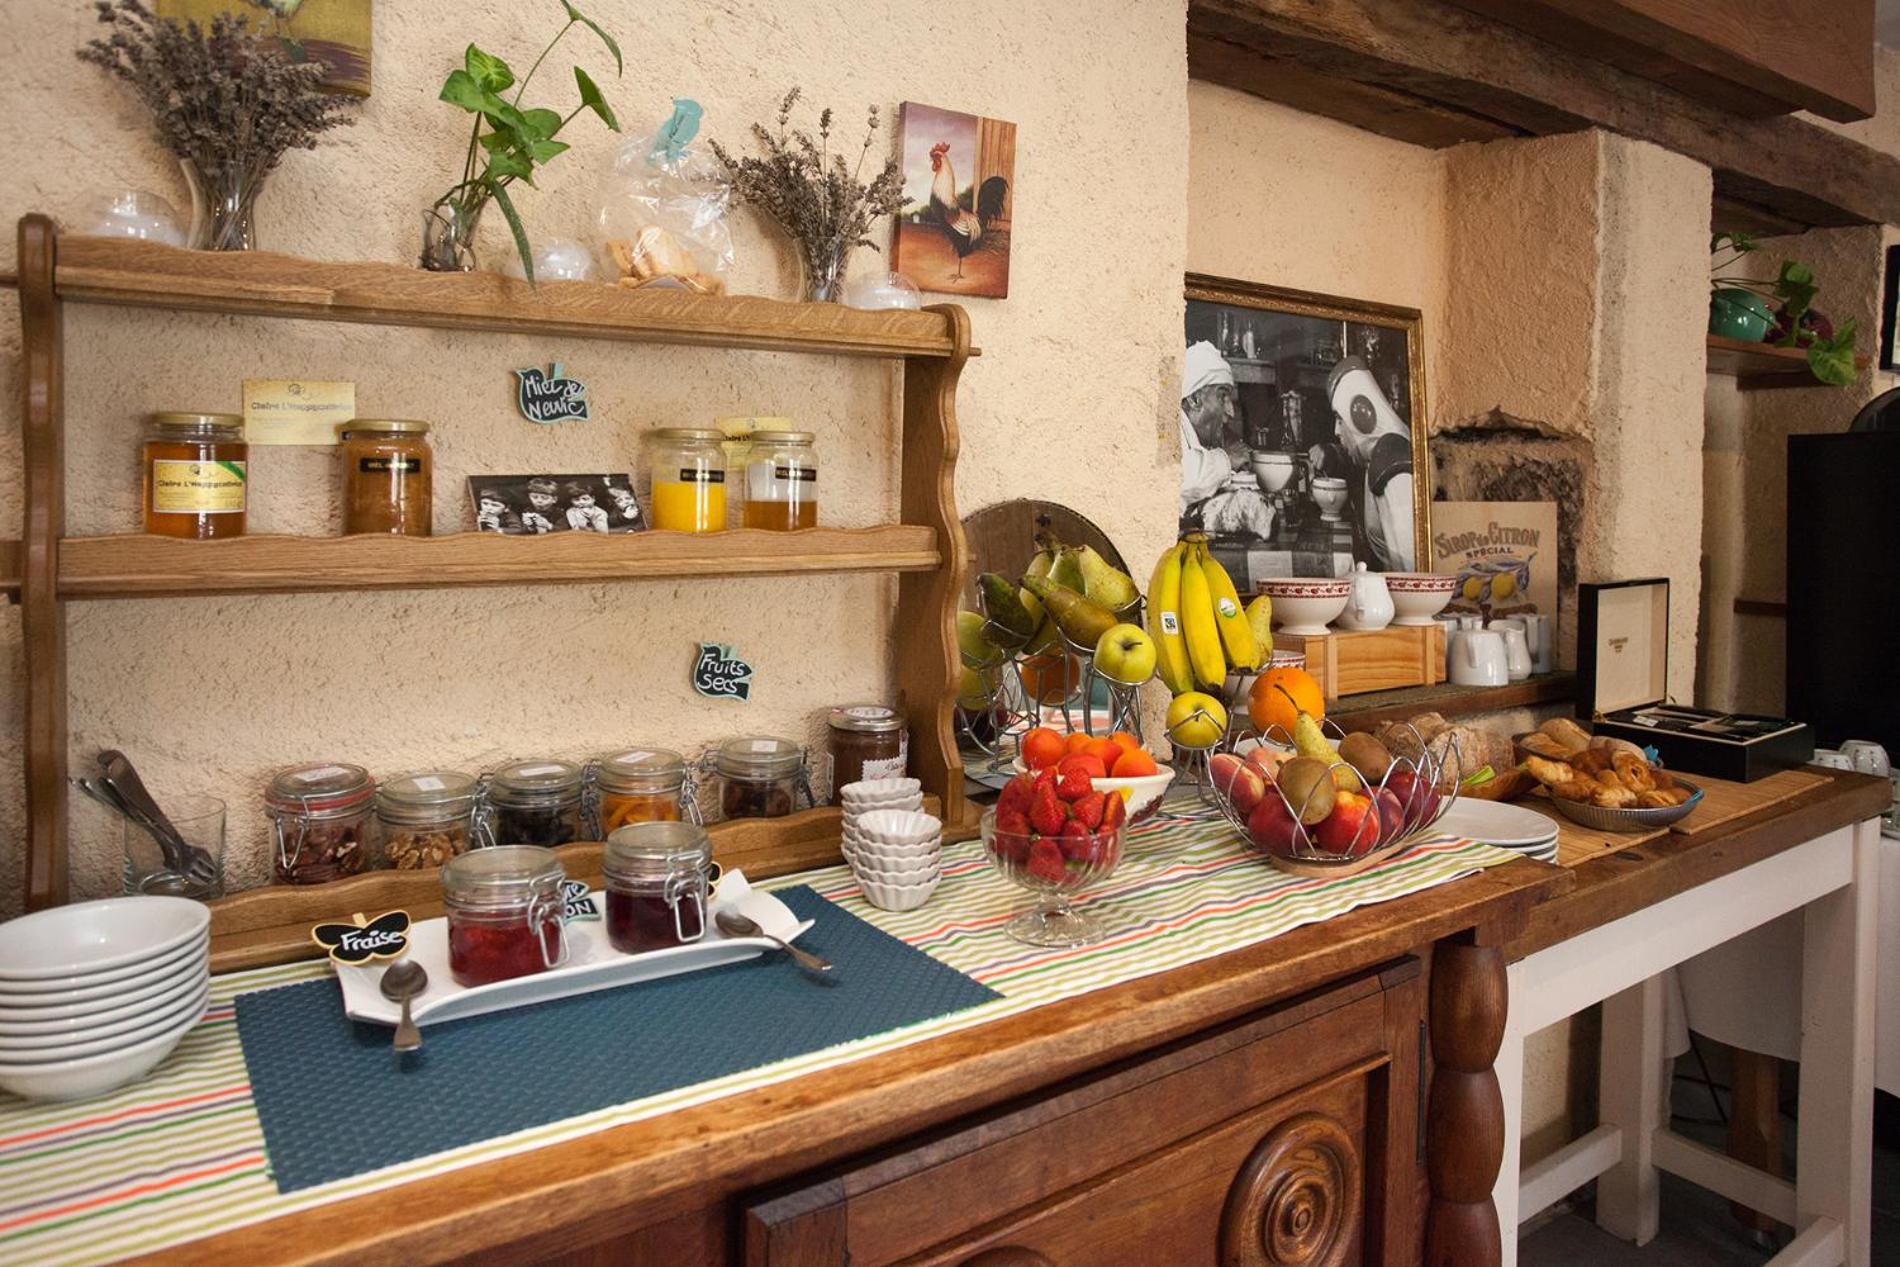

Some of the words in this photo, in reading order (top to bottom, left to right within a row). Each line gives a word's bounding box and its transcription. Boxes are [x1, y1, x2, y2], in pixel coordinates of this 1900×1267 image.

[1487, 521, 1540, 548] CITRON
[700, 653, 745, 676] Fruits
[697, 673, 738, 693] Secs
[340, 930, 404, 951] Fraise
